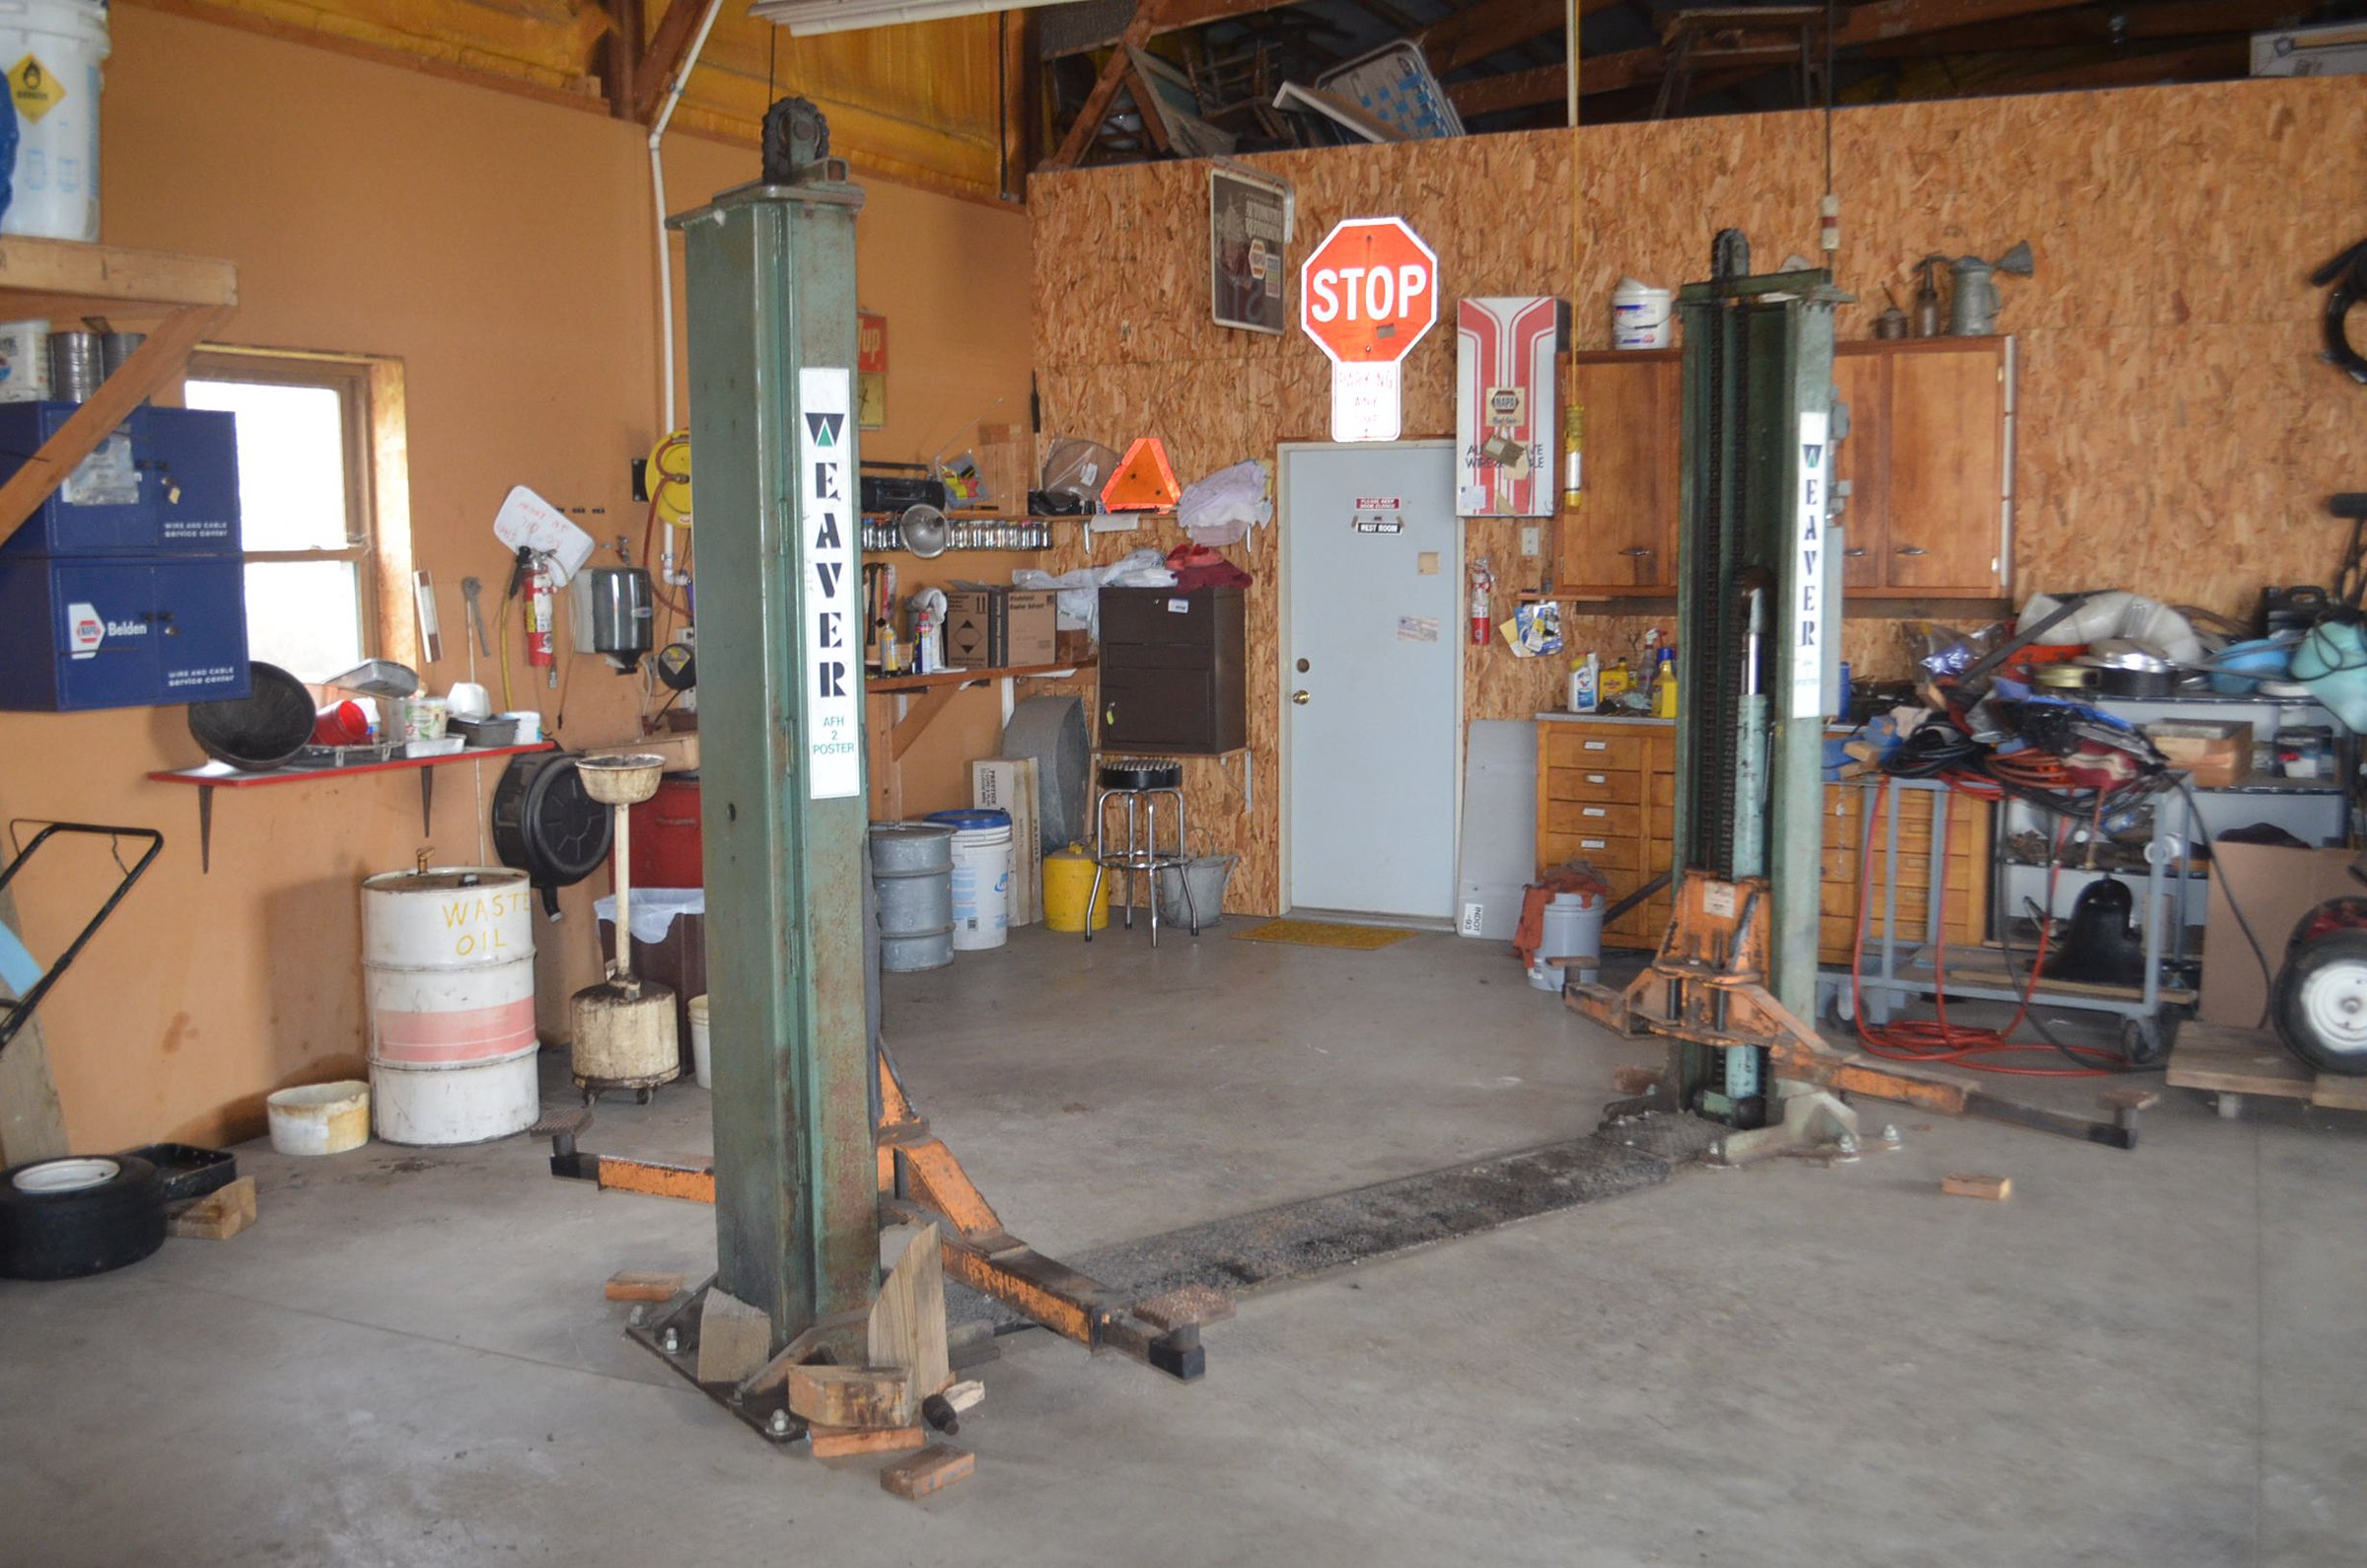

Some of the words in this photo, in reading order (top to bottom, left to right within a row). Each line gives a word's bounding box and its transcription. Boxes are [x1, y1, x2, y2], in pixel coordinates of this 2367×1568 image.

[1311, 264, 1427, 322] STOP
[1495, 397, 1515, 407] NAPA
[1801, 444, 1823, 646] WEAVER
[805, 412, 847, 698] WEAVER
[108, 620, 147, 637] Belden
[209, 667, 235, 676] CABLE
[169, 677, 203, 687] service
[204, 676, 235, 684] center
[823, 716, 845, 728] AFH
[830, 730, 838, 742] 2
[813, 743, 855, 755] POSTER
[442, 891, 531, 928] WASTE
[1472, 906, 1482, 933] INDOT
[456, 929, 507, 956] OIL
